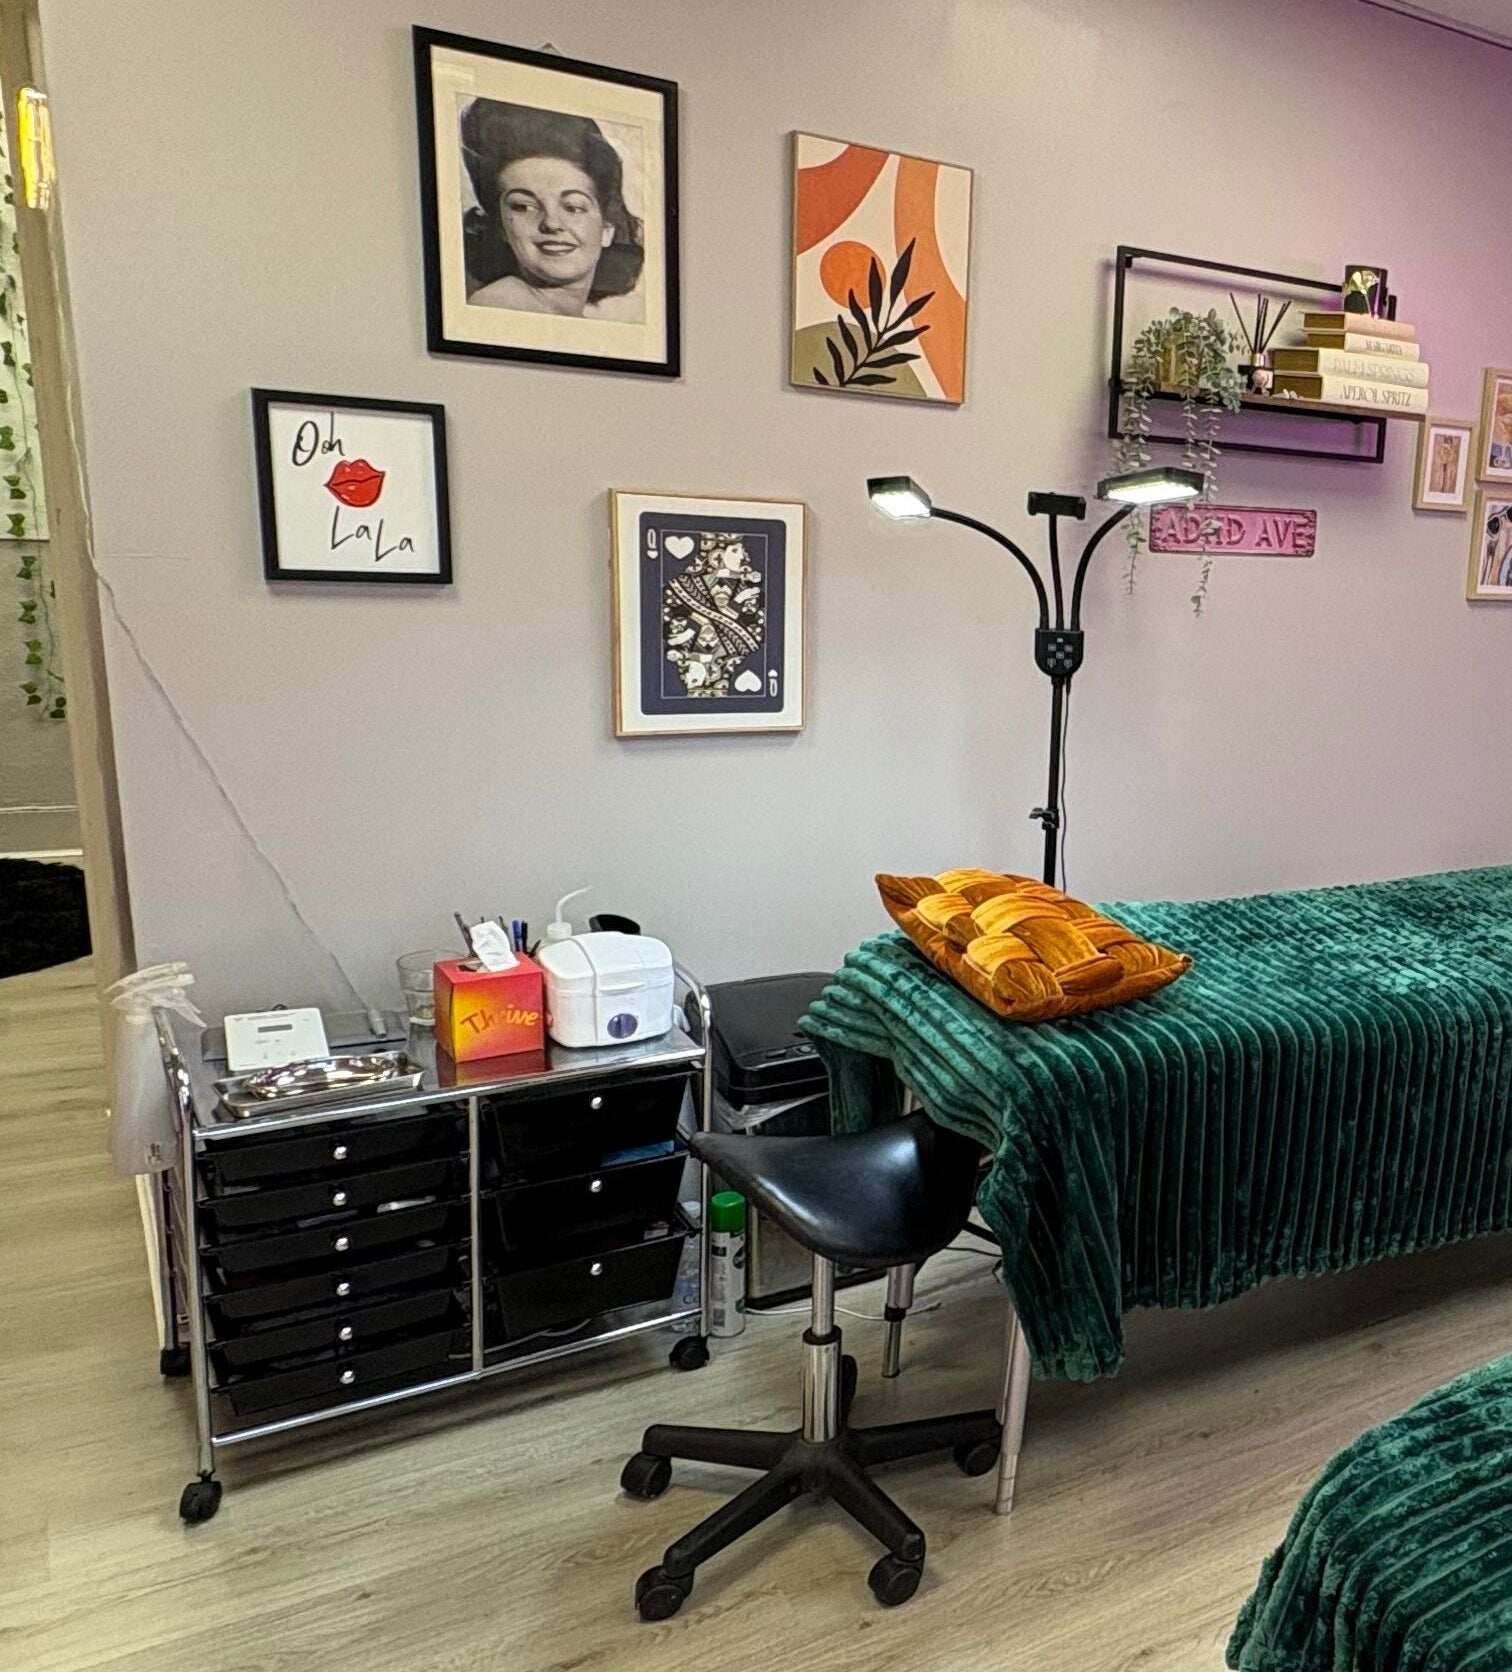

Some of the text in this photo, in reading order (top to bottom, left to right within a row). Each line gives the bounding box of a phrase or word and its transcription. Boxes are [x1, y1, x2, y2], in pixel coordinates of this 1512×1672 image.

[1340, 385, 1411, 407] APEROL SPRITZ
[1255, 515, 1308, 548] AVE
